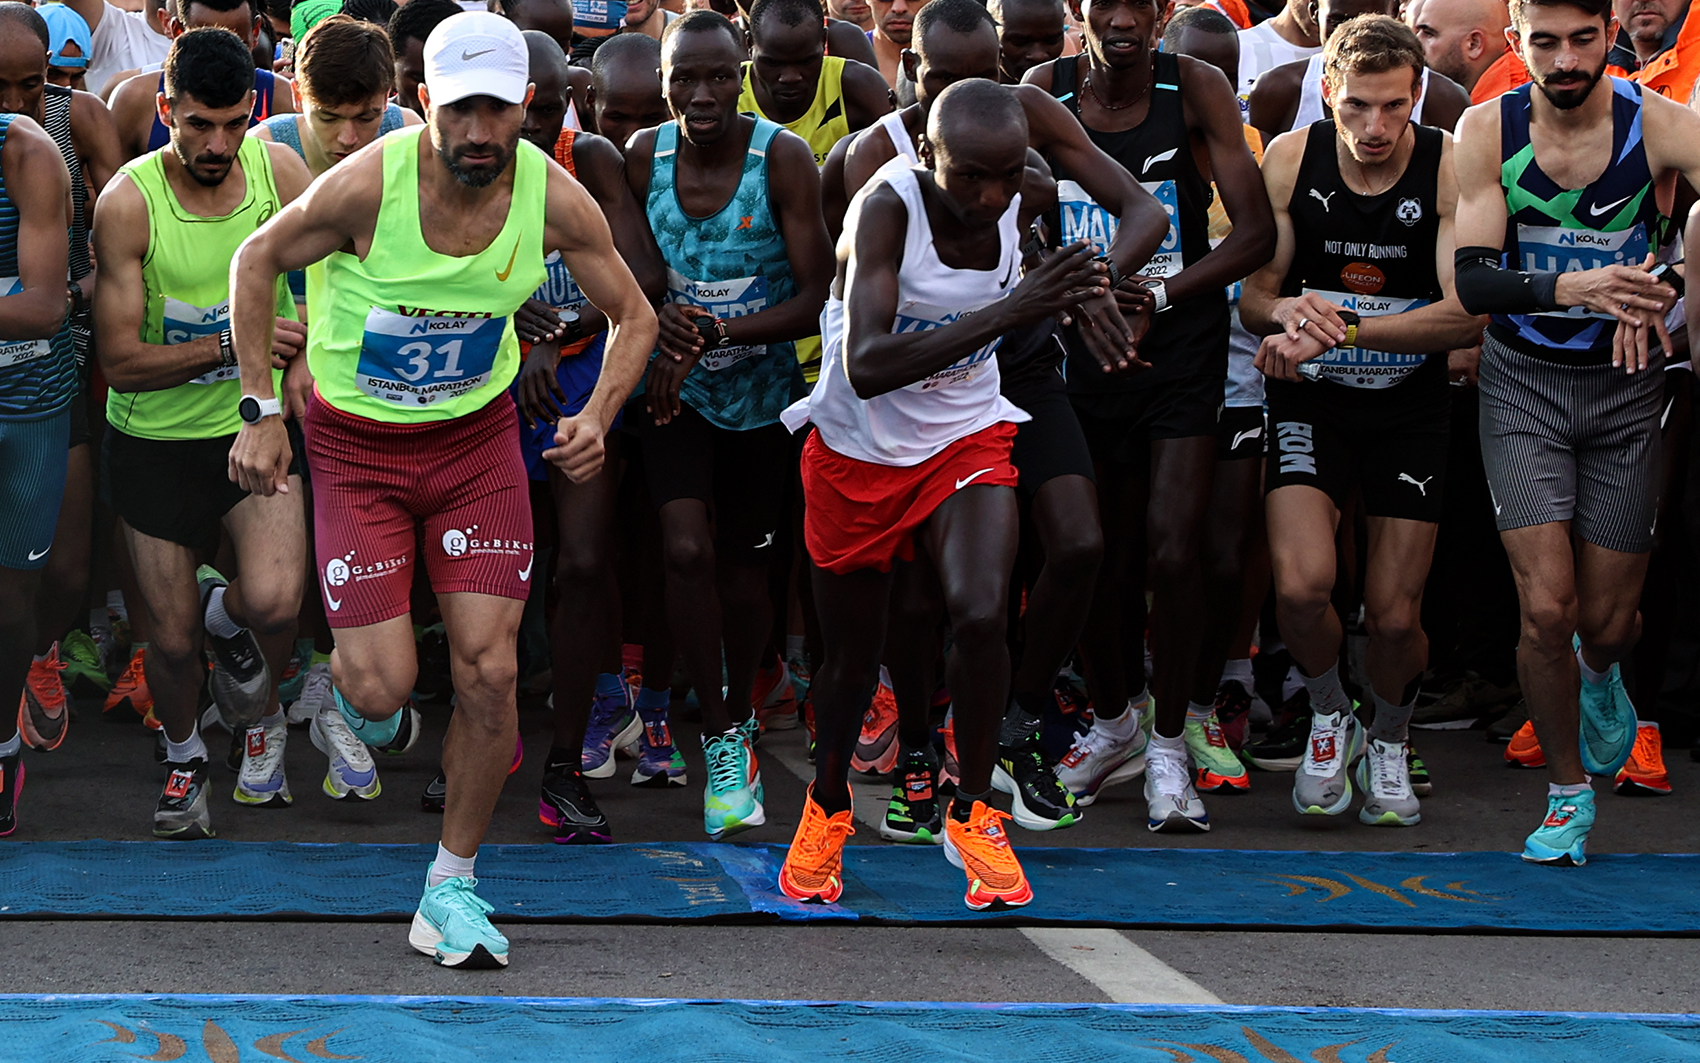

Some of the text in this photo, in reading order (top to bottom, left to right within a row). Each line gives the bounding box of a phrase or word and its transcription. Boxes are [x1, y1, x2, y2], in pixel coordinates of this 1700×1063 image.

[1575, 235, 1611, 246] KOLAY
[1325, 240, 1408, 259] NOT ONLY RUNNING
[1145, 266, 1168, 277] 2022
[697, 288, 730, 298] KOLAY
[1357, 301, 1391, 311] KOLAY
[429, 321, 468, 330] KOLAY
[12, 350, 36, 362] 2022
[393, 339, 465, 382] 31
[1319, 365, 1358, 375] TANBUL
[367, 376, 482, 395] ISTANBUL MARATHON
